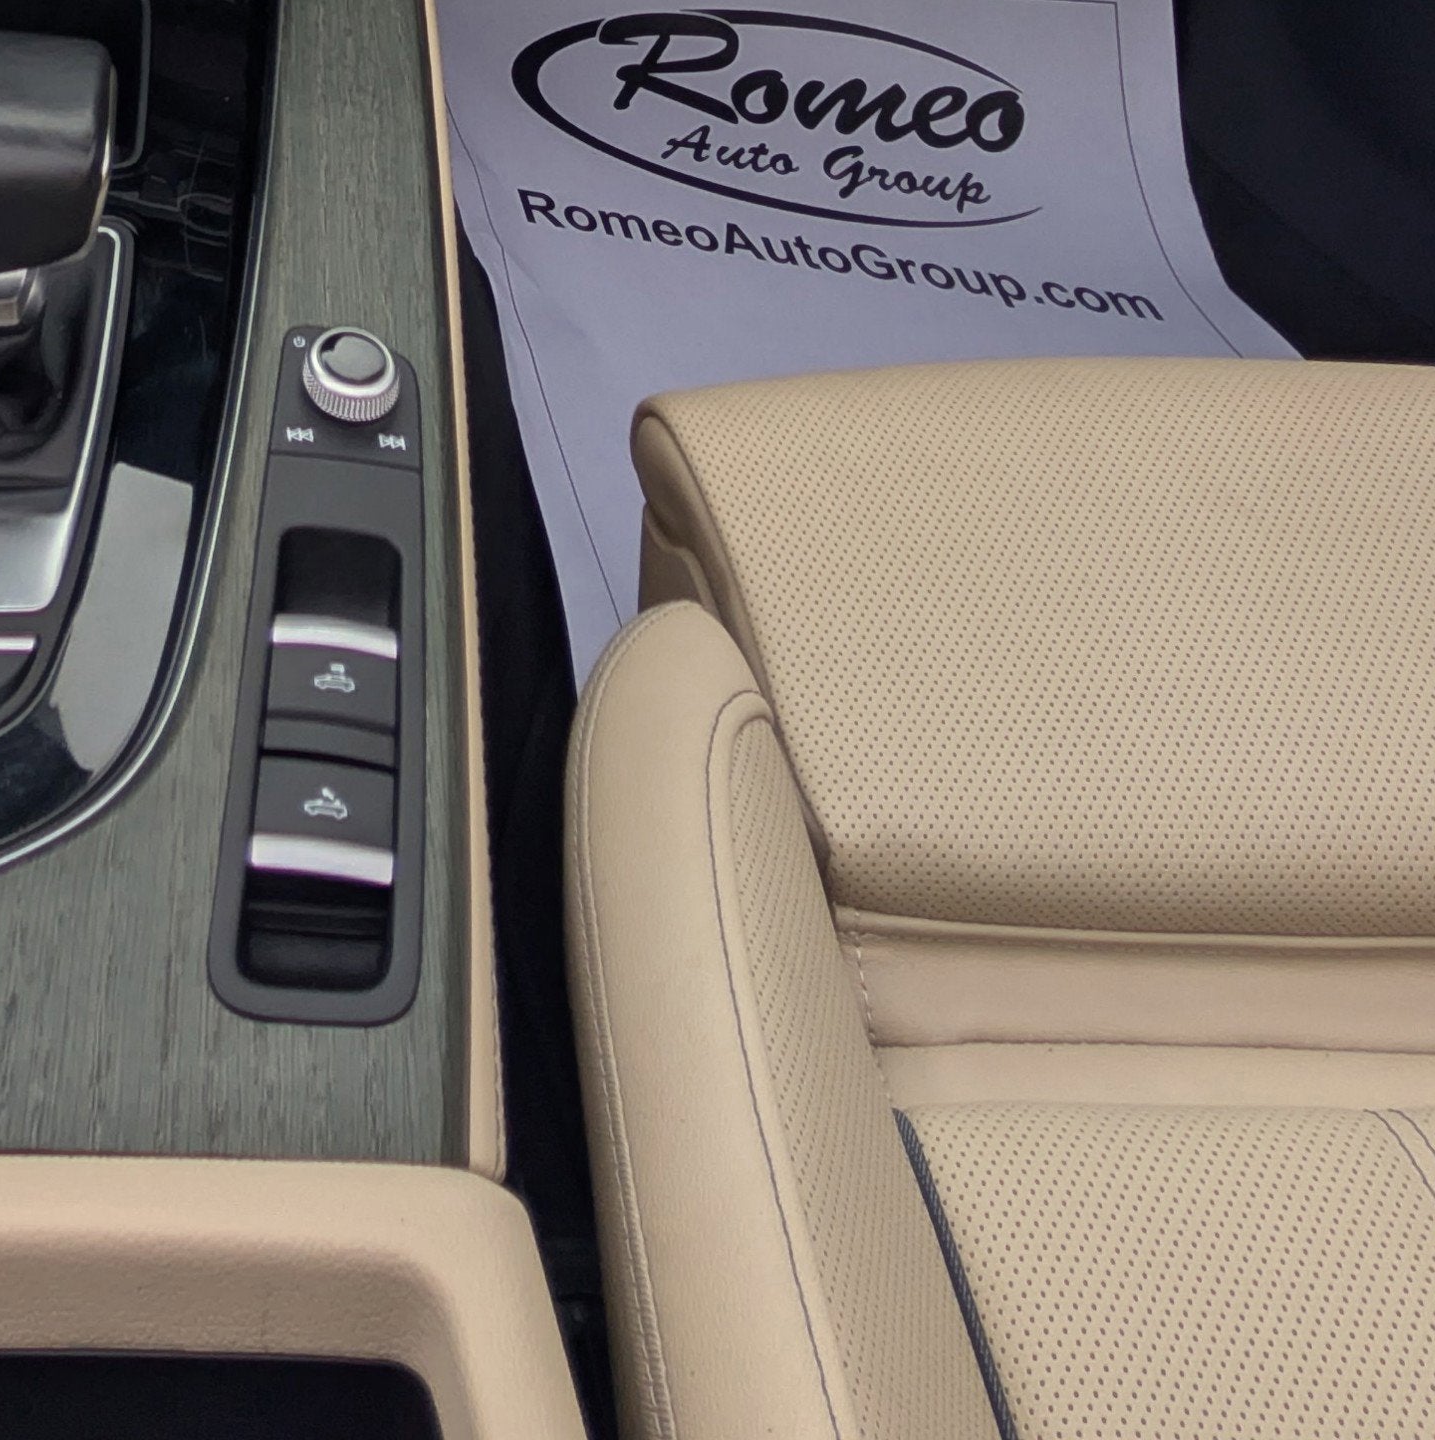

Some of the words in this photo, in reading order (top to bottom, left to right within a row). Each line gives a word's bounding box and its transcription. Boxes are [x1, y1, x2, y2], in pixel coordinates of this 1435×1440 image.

[598, 10, 1025, 154] Romeo
[661, 124, 800, 177] Auto
[823, 144, 992, 210] Group
[516, 188, 1165, 323] RomeoAutoGroup.com
